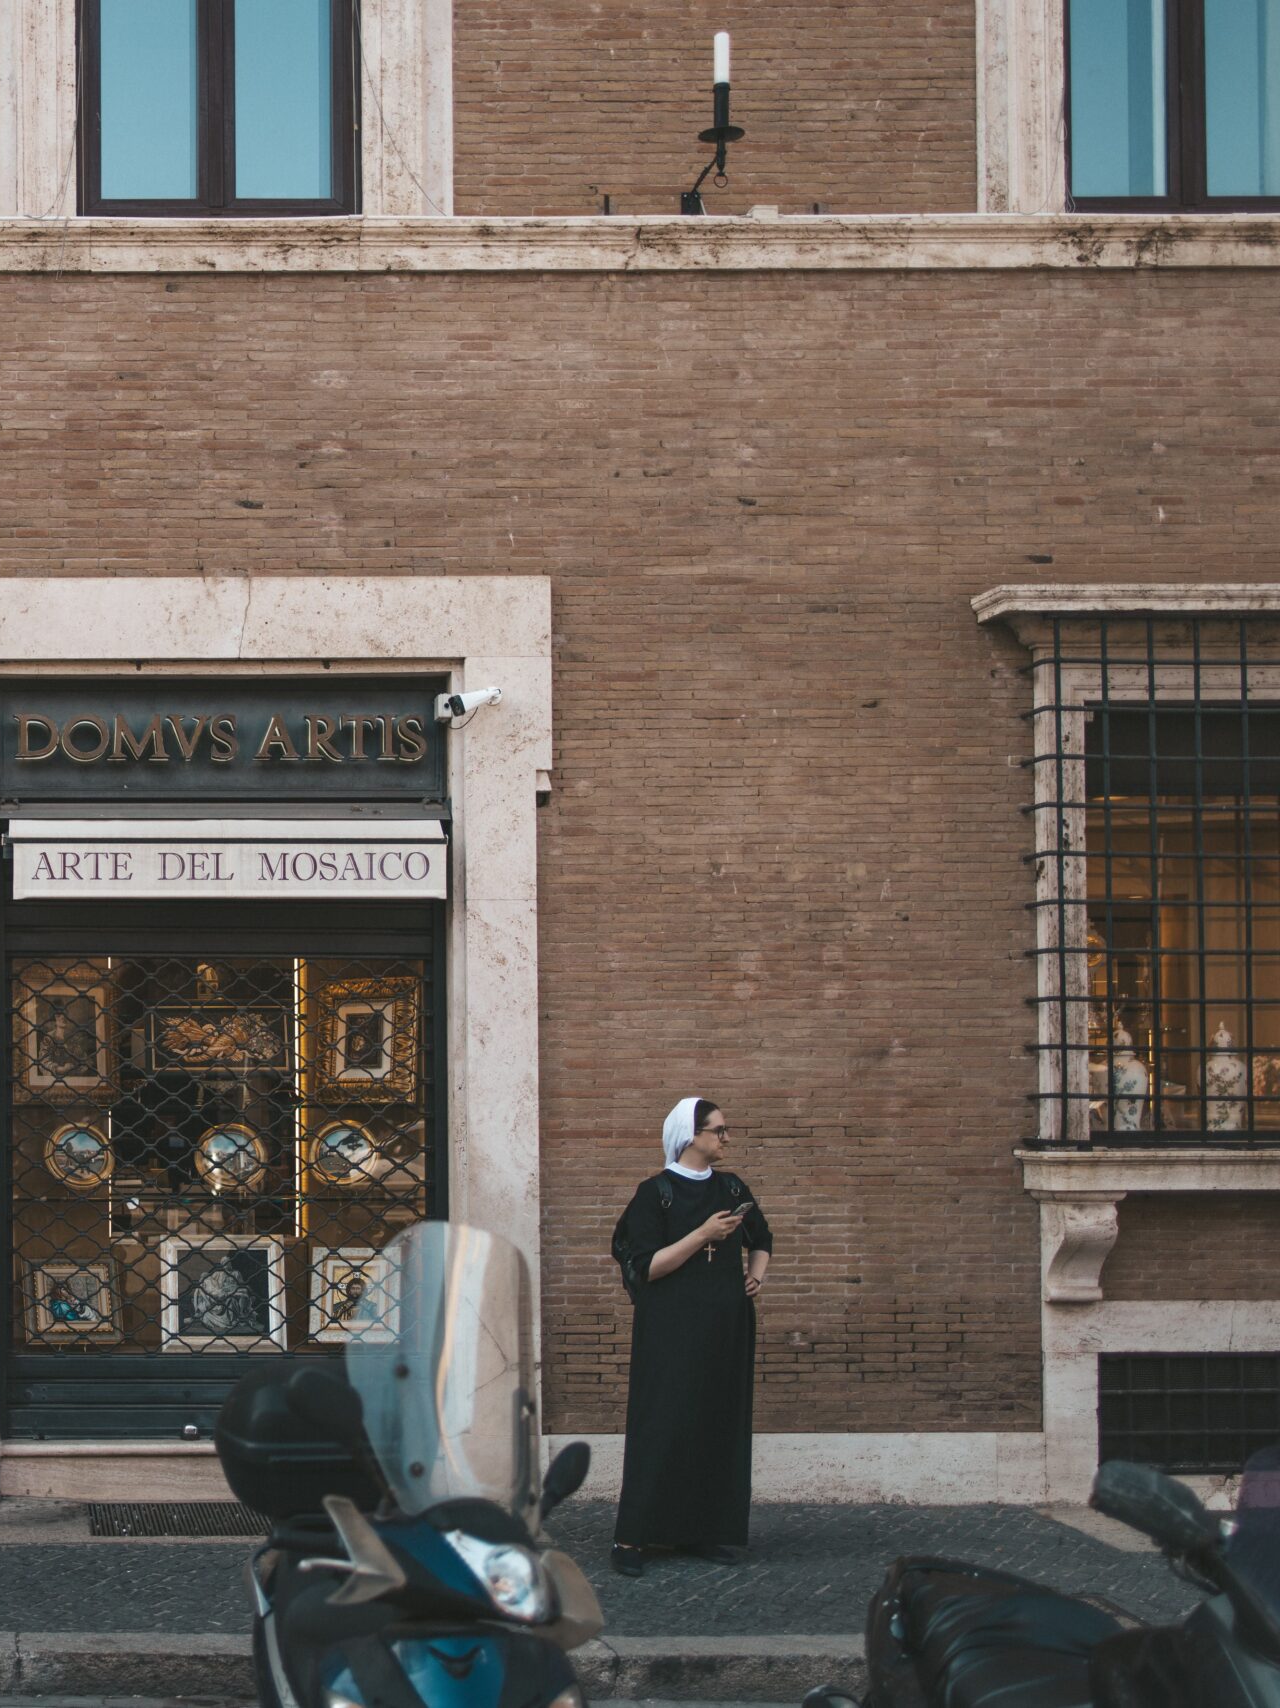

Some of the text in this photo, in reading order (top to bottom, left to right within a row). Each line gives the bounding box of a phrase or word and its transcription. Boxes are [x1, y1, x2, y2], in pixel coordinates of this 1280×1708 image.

[13, 713, 428, 763] DOMVS ARTIS
[31, 851, 430, 881] ARTE DEL MOSAICO
